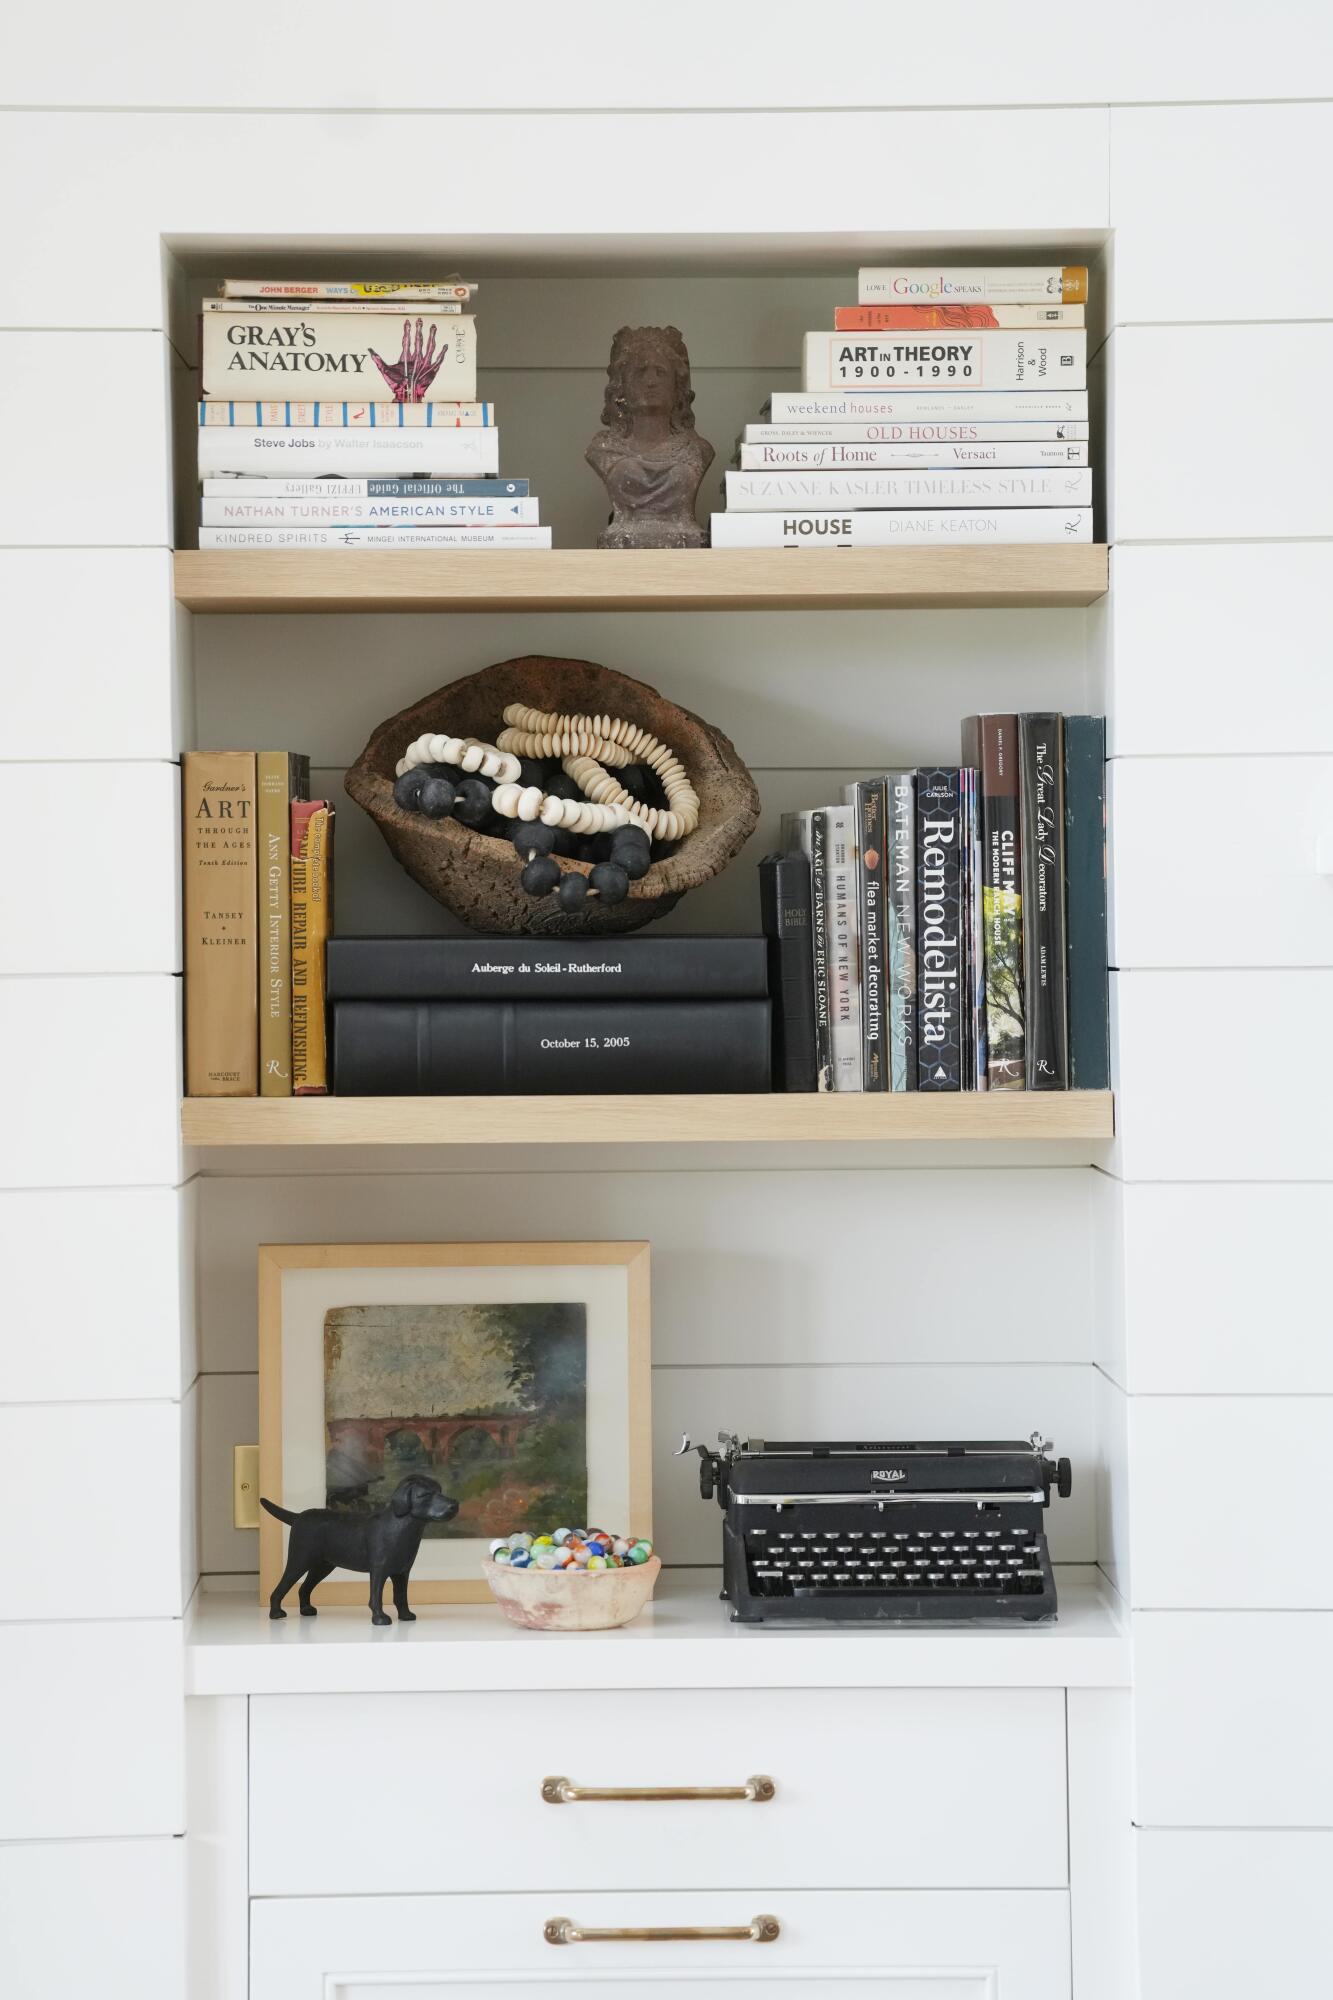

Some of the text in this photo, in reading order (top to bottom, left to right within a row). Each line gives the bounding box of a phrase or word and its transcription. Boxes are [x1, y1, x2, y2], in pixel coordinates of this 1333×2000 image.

[260, 286, 282, 294] JOHN
[284, 286, 318, 294] BERGER
[866, 284, 887, 292] LOWE
[893, 276, 952, 298] Google
[227, 322, 316, 347] GRAY'S
[227, 352, 368, 373] ANATOMY
[839, 345, 973, 362] ART IN THEORY
[1016, 341, 1024, 382] Harrison
[1038, 348, 1047, 377] Wood
[788, 402, 894, 414] weekend houses
[254, 438, 286, 448] Steve
[288, 438, 316, 448] Jobs
[866, 426, 978, 440] OLD HOUSES
[764, 446, 808, 462] Roots
[813, 448, 828, 466] of
[832, 446, 877, 462] Home
[953, 448, 996, 460] Versaci
[286, 484, 322, 494] Gallery
[370, 483, 464, 494] The Official Guide
[740, 479, 1051, 496] SUZANNE KASLER TIMELESS STYLE
[224, 506, 494, 517] NATHAN TURNER'S AMERICAN STYLE
[216, 533, 273, 544] KINDRED
[278, 533, 328, 543] SPIRITS
[784, 519, 997, 536] HOUSE DIANE KEATON
[202, 781, 246, 792] Gardner's
[196, 798, 250, 818] ART
[864, 802, 872, 833] Homes
[316, 818, 324, 832] The
[1035, 744, 1056, 912] The Great Lady Decorators
[312, 834, 322, 872] complete
[814, 851, 823, 876] AGE
[1002, 830, 1014, 876] CLIFF
[992, 848, 1000, 884] MODERN
[868, 880, 880, 906] flea
[1002, 880, 1015, 916] MAY
[268, 833, 283, 1018] ANN GETTY INTERIOR STYLE
[784, 908, 808, 918] HOLY
[786, 918, 808, 927] BIBLE
[815, 892, 824, 934] BARNS
[894, 786, 912, 1046] BATEMAN NEW WORKS
[293, 903, 307, 950] REPAIR
[868, 911, 880, 960] market
[924, 817, 957, 1046] Remodelista
[994, 918, 1002, 946] HOUSE
[202, 937, 246, 945] KLEINER
[836, 875, 850, 1021] HUMANS OF NEW YORK
[293, 958, 308, 986] AND
[472, 963, 514, 974] Auberge
[518, 963, 531, 972] du
[816, 950, 826, 978] ERIC
[818, 981, 828, 1027] SLOANE
[868, 963, 882, 1040] decorating
[293, 995, 308, 1081] REFINISHING
[540, 1037, 630, 1049] October 15, 2005
[872, 1470, 906, 1480] ROYAL
